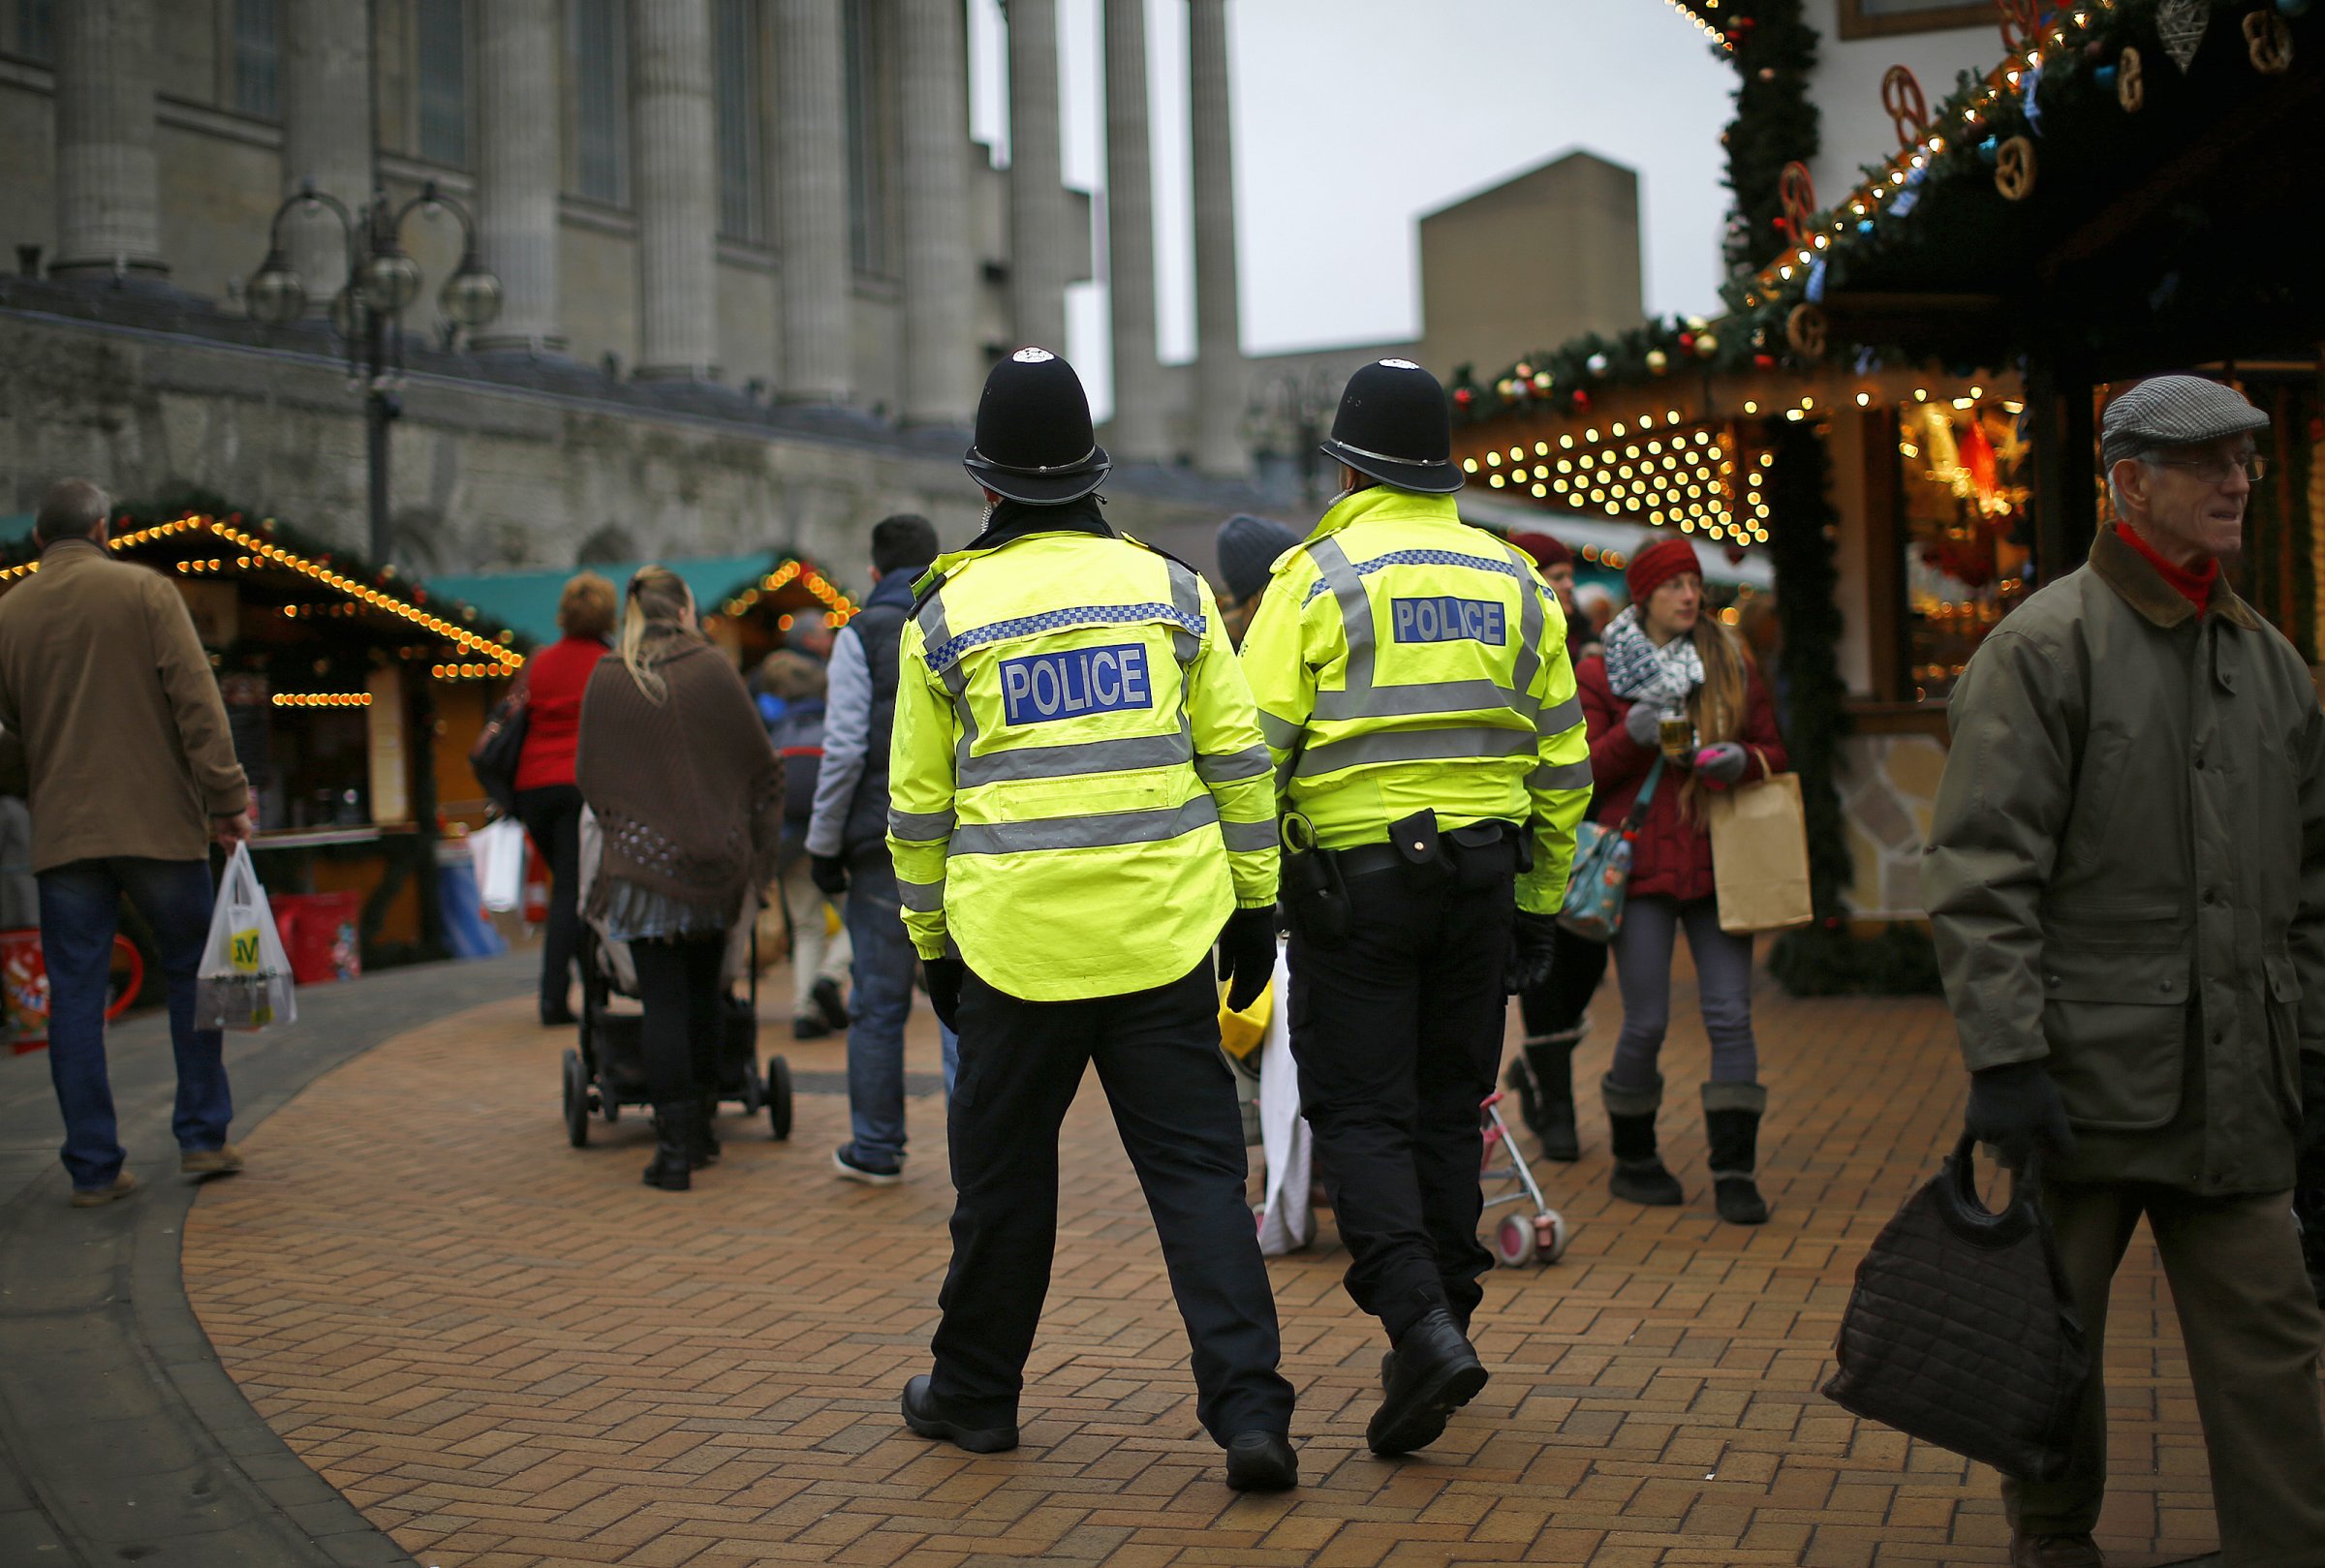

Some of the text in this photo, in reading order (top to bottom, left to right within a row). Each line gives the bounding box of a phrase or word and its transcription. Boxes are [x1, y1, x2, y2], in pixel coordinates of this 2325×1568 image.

[1395, 599, 1501, 644] POLICE
[1005, 649, 1146, 719] POLICE
[233, 936, 260, 965] M
